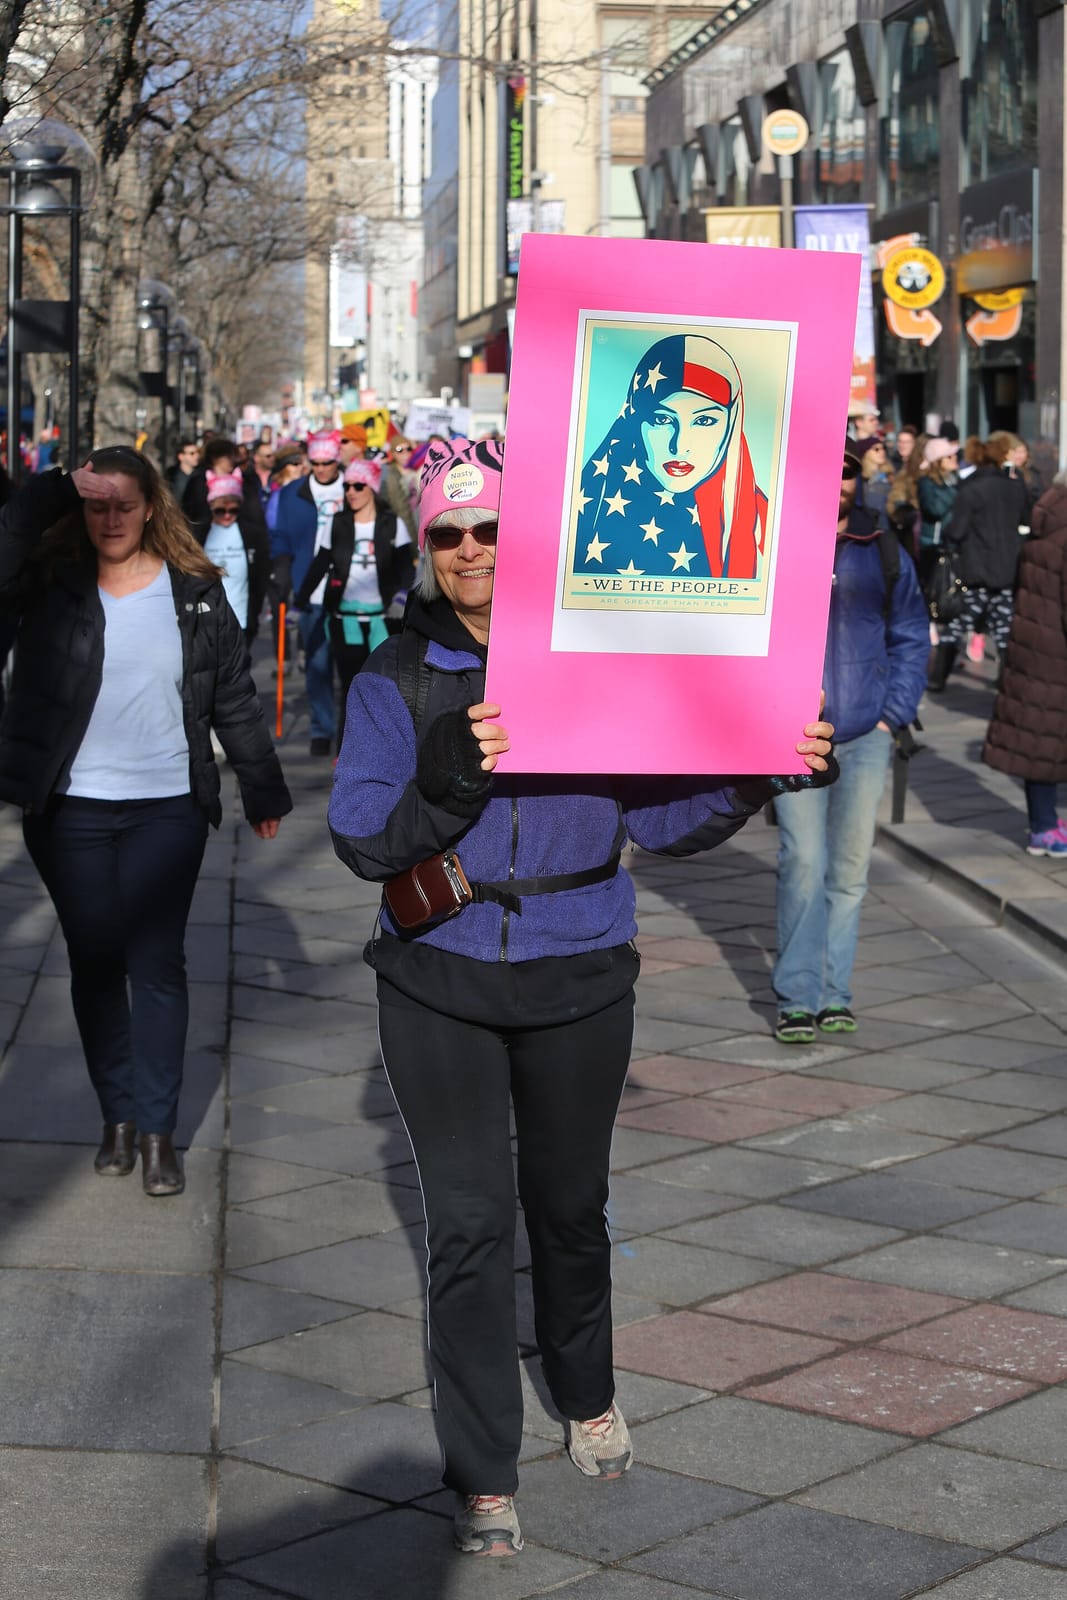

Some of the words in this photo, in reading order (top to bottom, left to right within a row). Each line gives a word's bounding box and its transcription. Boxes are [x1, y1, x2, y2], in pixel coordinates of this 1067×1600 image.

[451, 471, 473, 479] Nasty
[447, 480, 478, 491] Woman
[593, 579, 623, 591] WE
[629, 580, 665, 592] THE
[671, 582, 739, 594] PEOPLE
